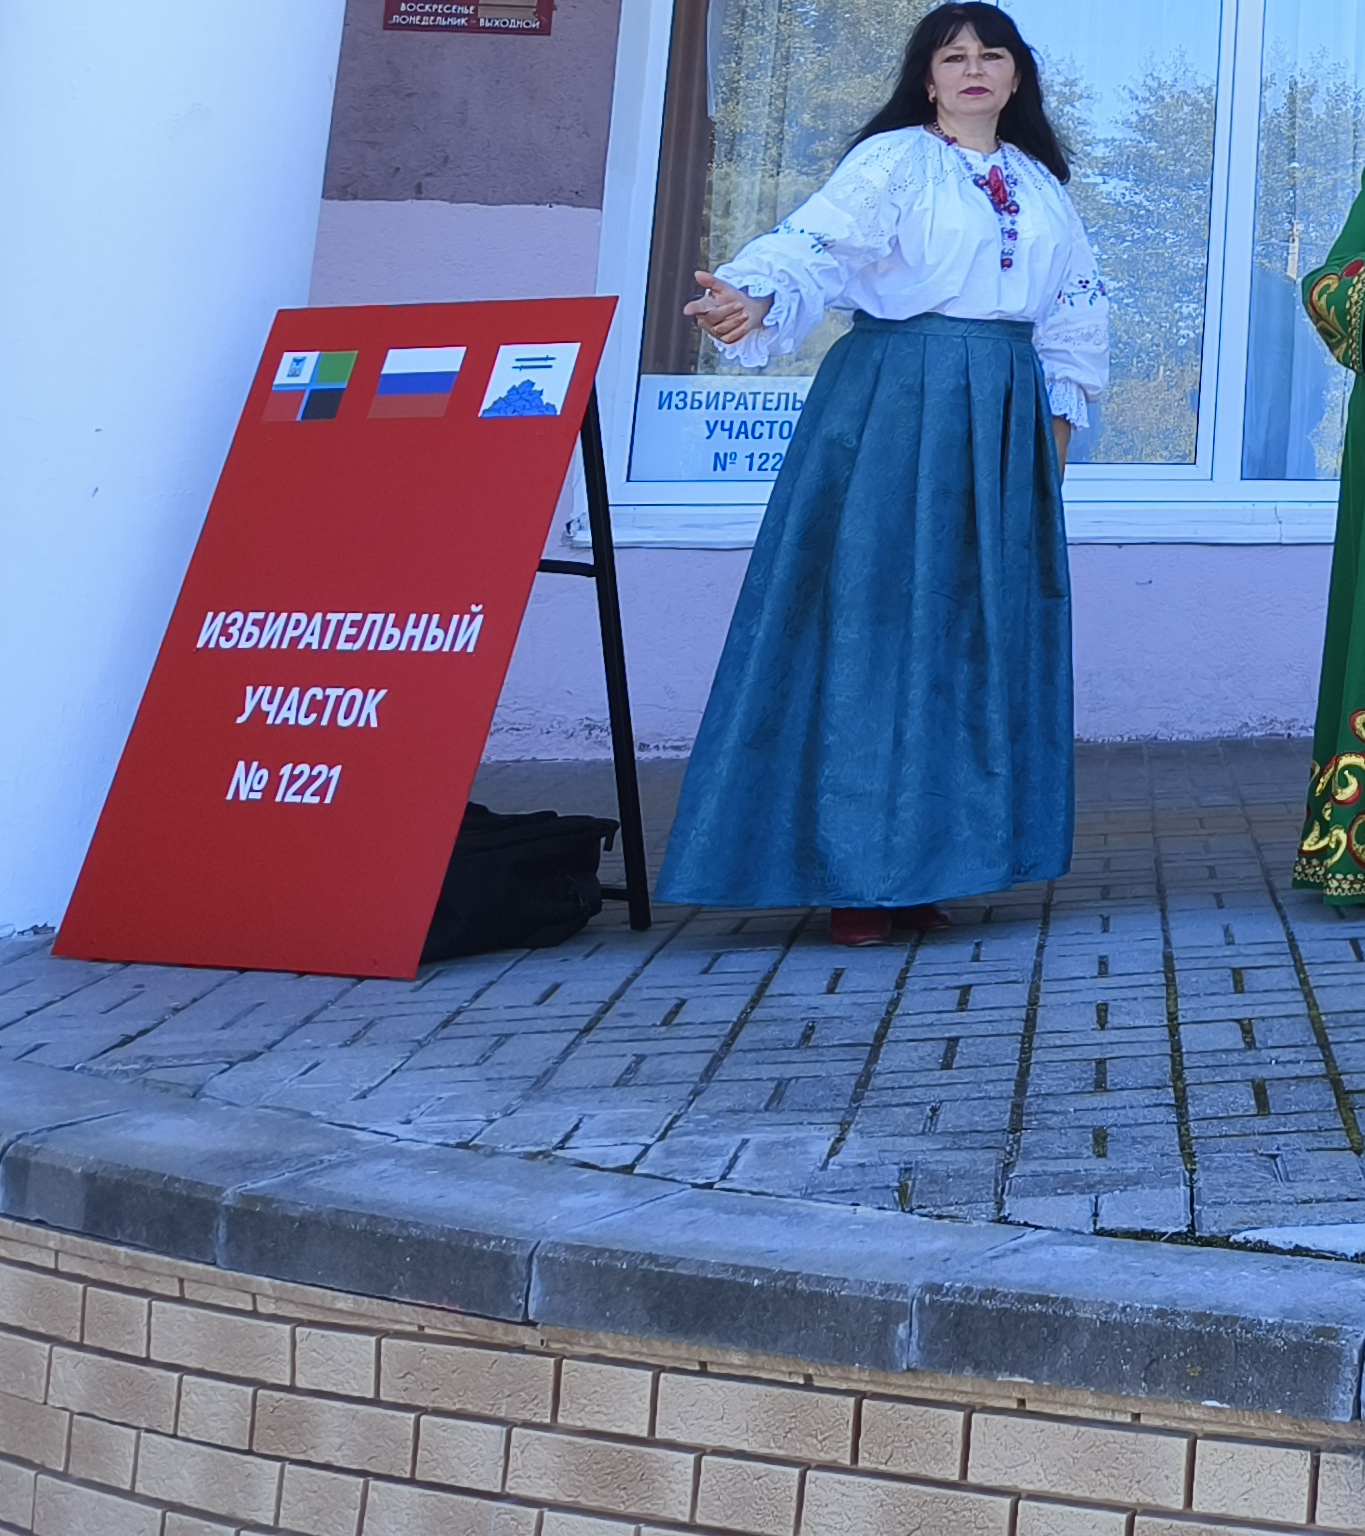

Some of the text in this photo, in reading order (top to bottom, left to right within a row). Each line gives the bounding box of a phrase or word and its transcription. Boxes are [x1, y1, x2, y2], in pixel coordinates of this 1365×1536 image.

[400, 2, 475, 14] ВОСКРЕСЕНЬЕ
[391, 15, 468, 27] ПОНЕДЕЛЬНИК
[479, 17, 541, 30] ВЫХОДНОЙ
[657, 390, 804, 412] ИЗБИРАТЕЛЬ
[704, 419, 793, 441] УЧАСТО
[712, 451, 783, 472] № 122
[196, 604, 484, 653] ИЗБИРАТЕЛЬНЫЙ
[235, 685, 388, 728] УЧАСТОК
[225, 760, 343, 804] № 1221
